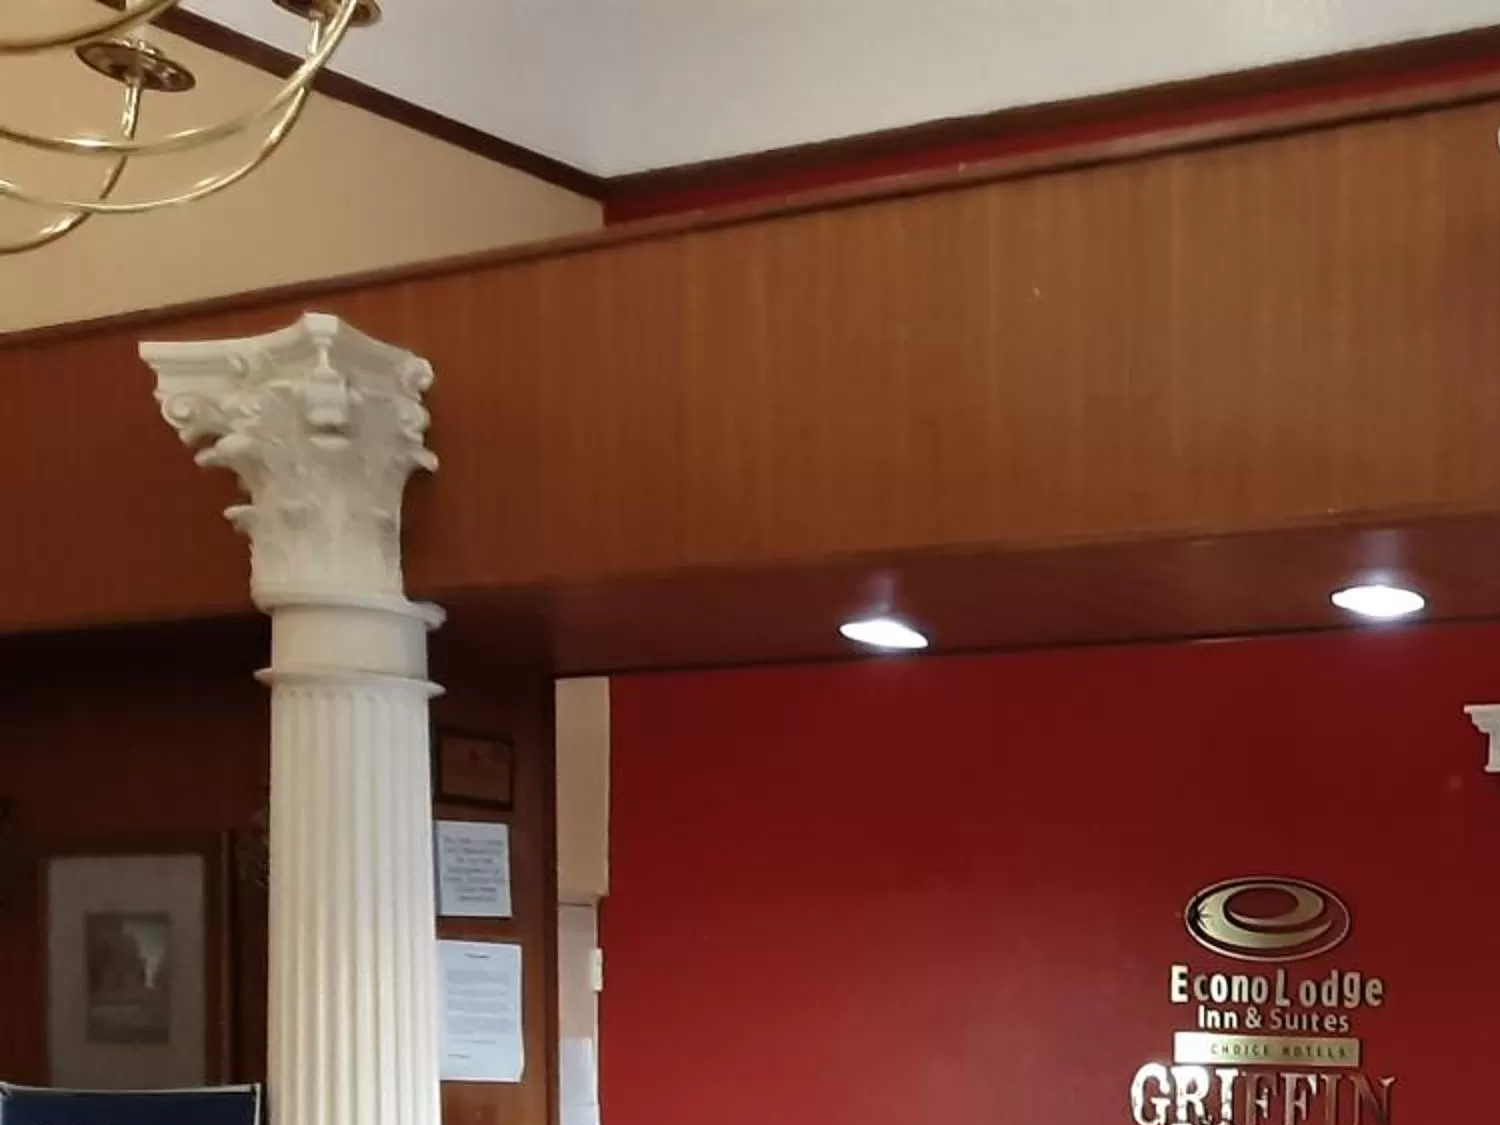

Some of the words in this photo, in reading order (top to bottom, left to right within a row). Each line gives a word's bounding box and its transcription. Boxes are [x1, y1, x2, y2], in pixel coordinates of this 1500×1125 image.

[1198, 1004, 1238, 1030] Inn
[1245, 1006, 1262, 1029] &
[1269, 1007, 1350, 1032] Suites
[1211, 1043, 1270, 1057] CHOICE
[1282, 1045, 1348, 1059] HOTELS
